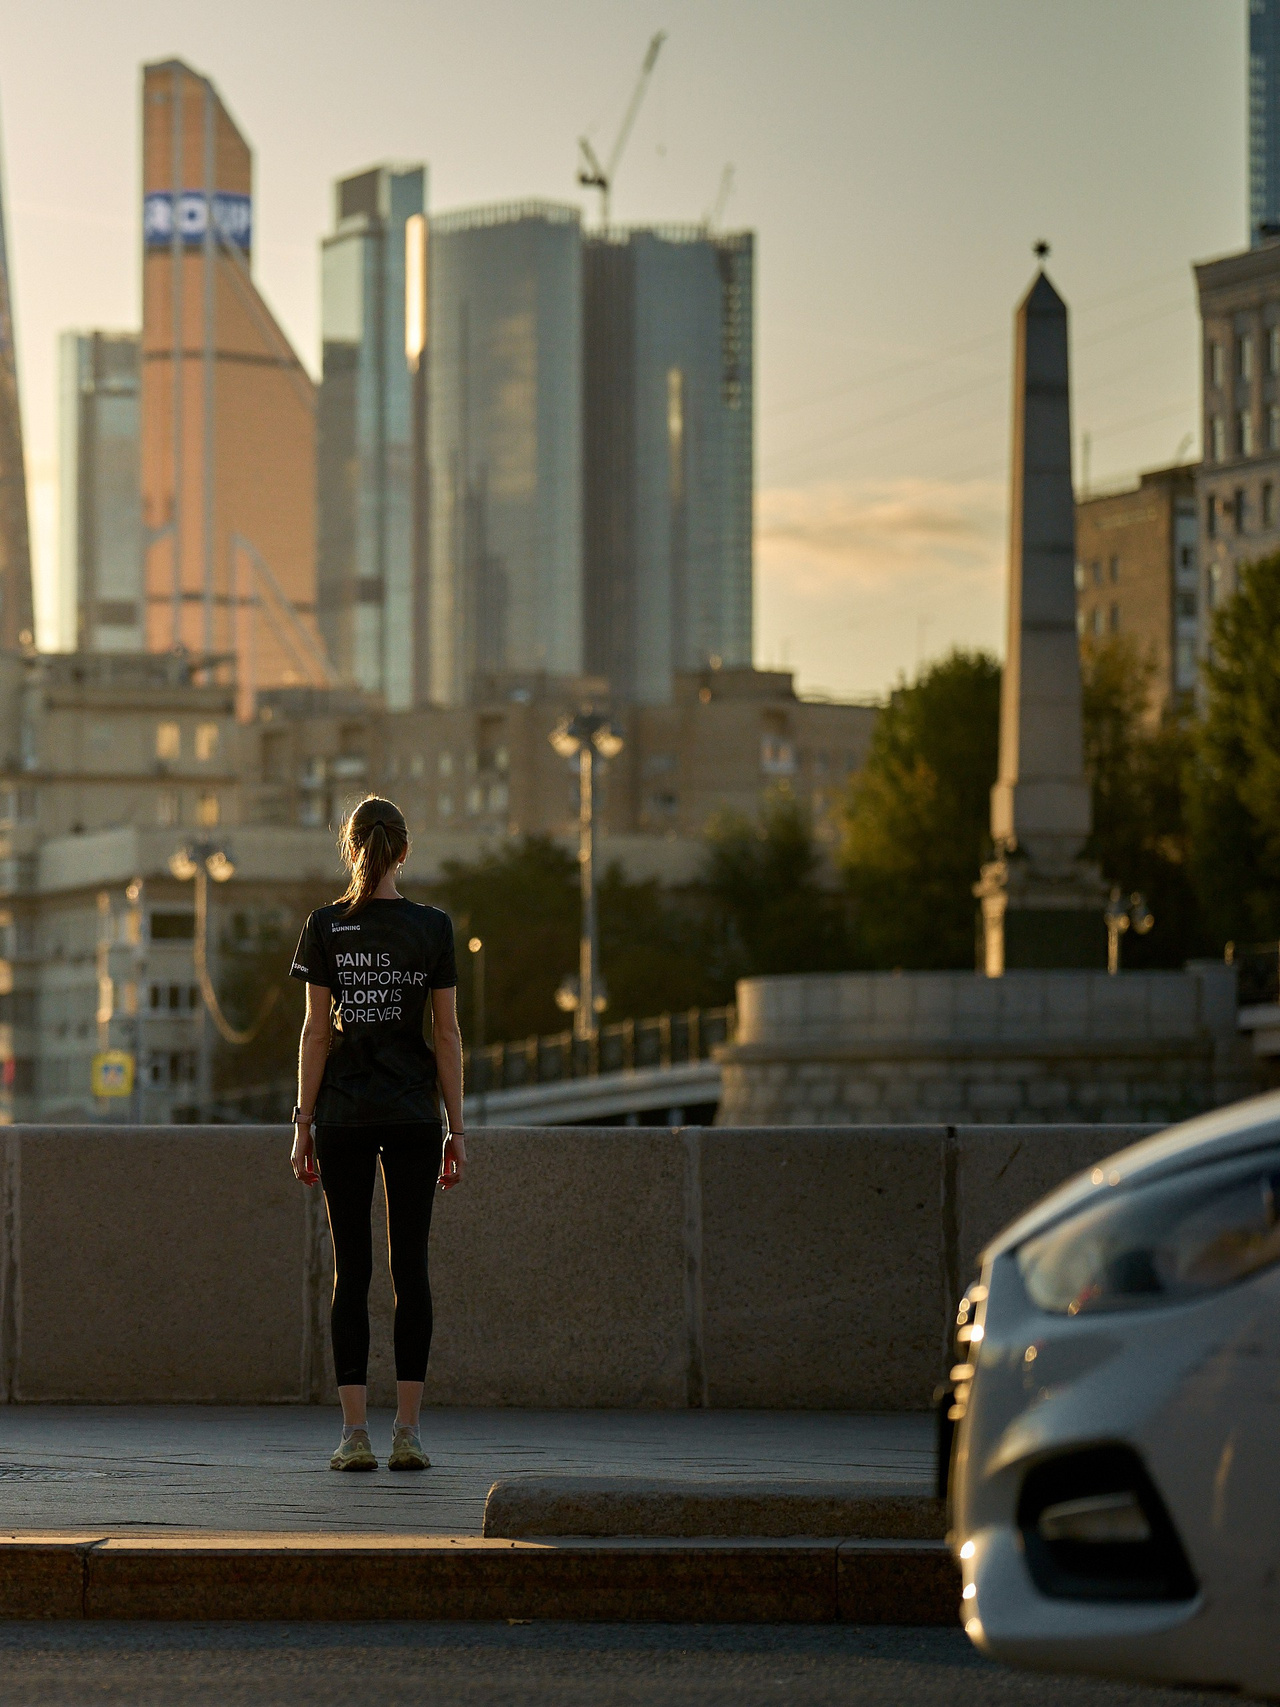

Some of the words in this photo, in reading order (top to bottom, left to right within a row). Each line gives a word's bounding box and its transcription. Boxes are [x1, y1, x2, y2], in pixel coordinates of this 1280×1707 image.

[332, 925, 361, 933] RUNNING
[335, 952, 372, 968] PAIN
[376, 953, 391, 967] IS
[337, 970, 428, 987] TEMPORAR
[390, 988, 402, 1002] IS
